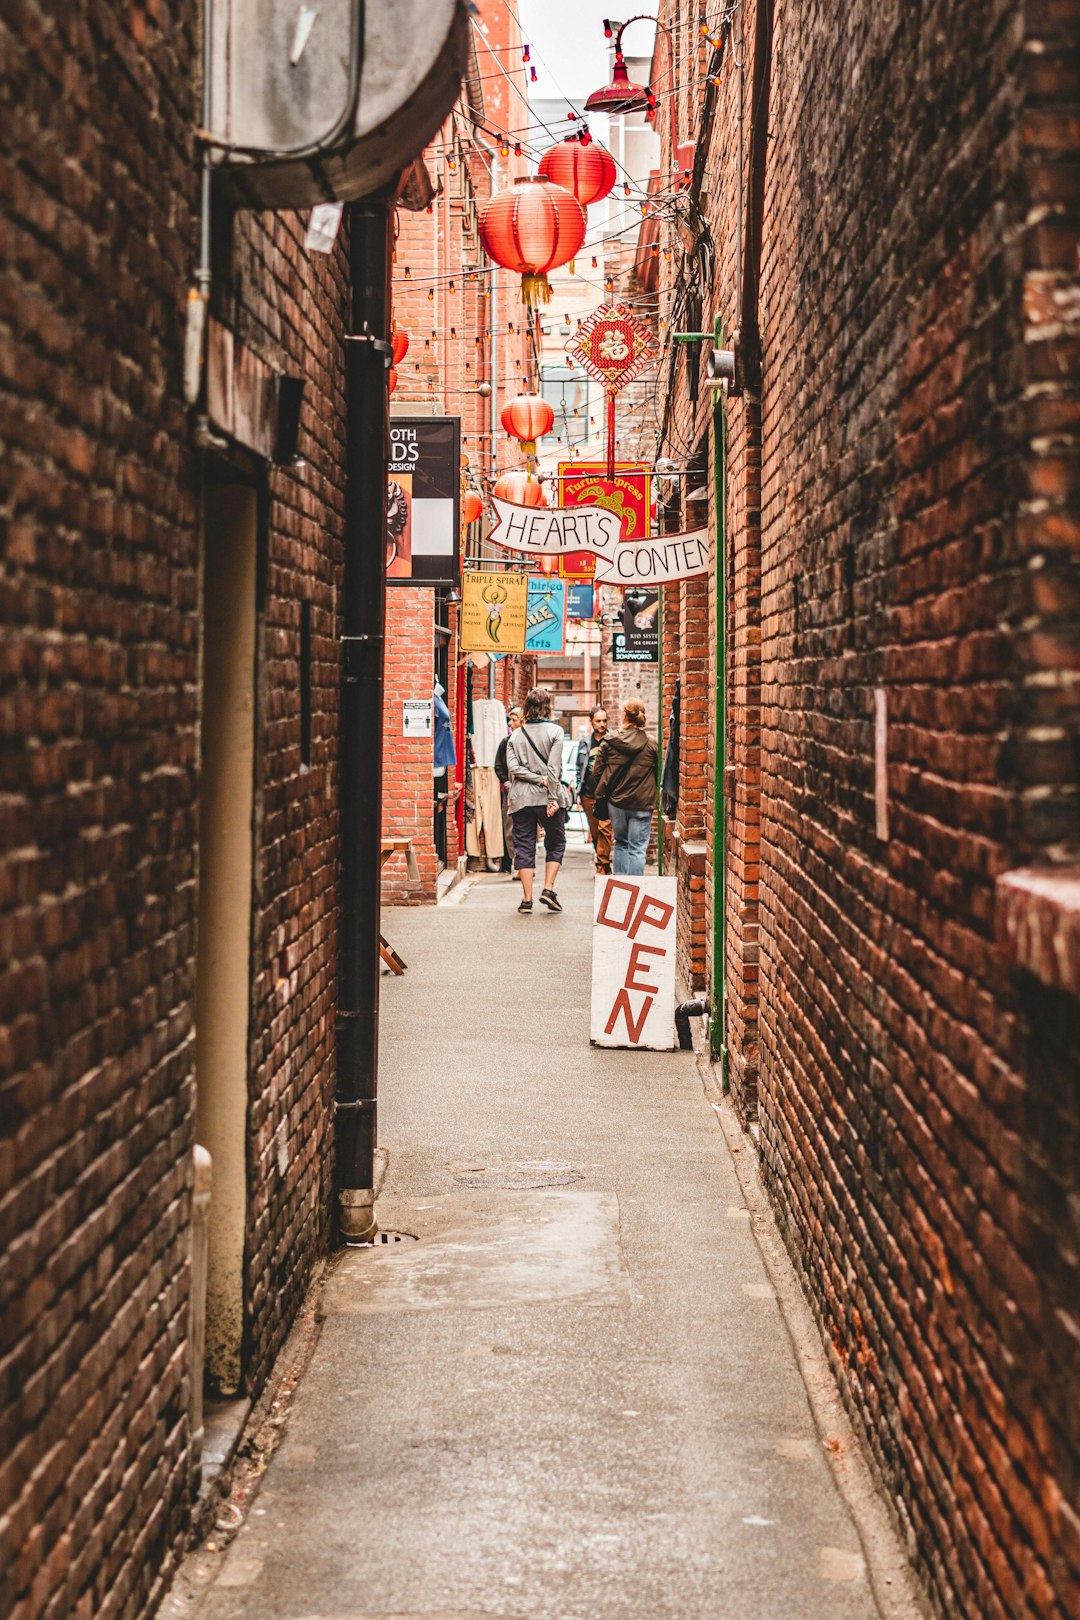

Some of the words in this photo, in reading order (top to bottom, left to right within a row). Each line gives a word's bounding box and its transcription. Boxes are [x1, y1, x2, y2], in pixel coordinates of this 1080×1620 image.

[565, 476, 600, 495] Turtle
[505, 512, 612, 548] HEART'S
[466, 574, 494, 584] TRIPLE
[496, 575, 526, 586] SPIRAL
[526, 638, 552, 648] Arts
[596, 878, 675, 1045] OPEN
